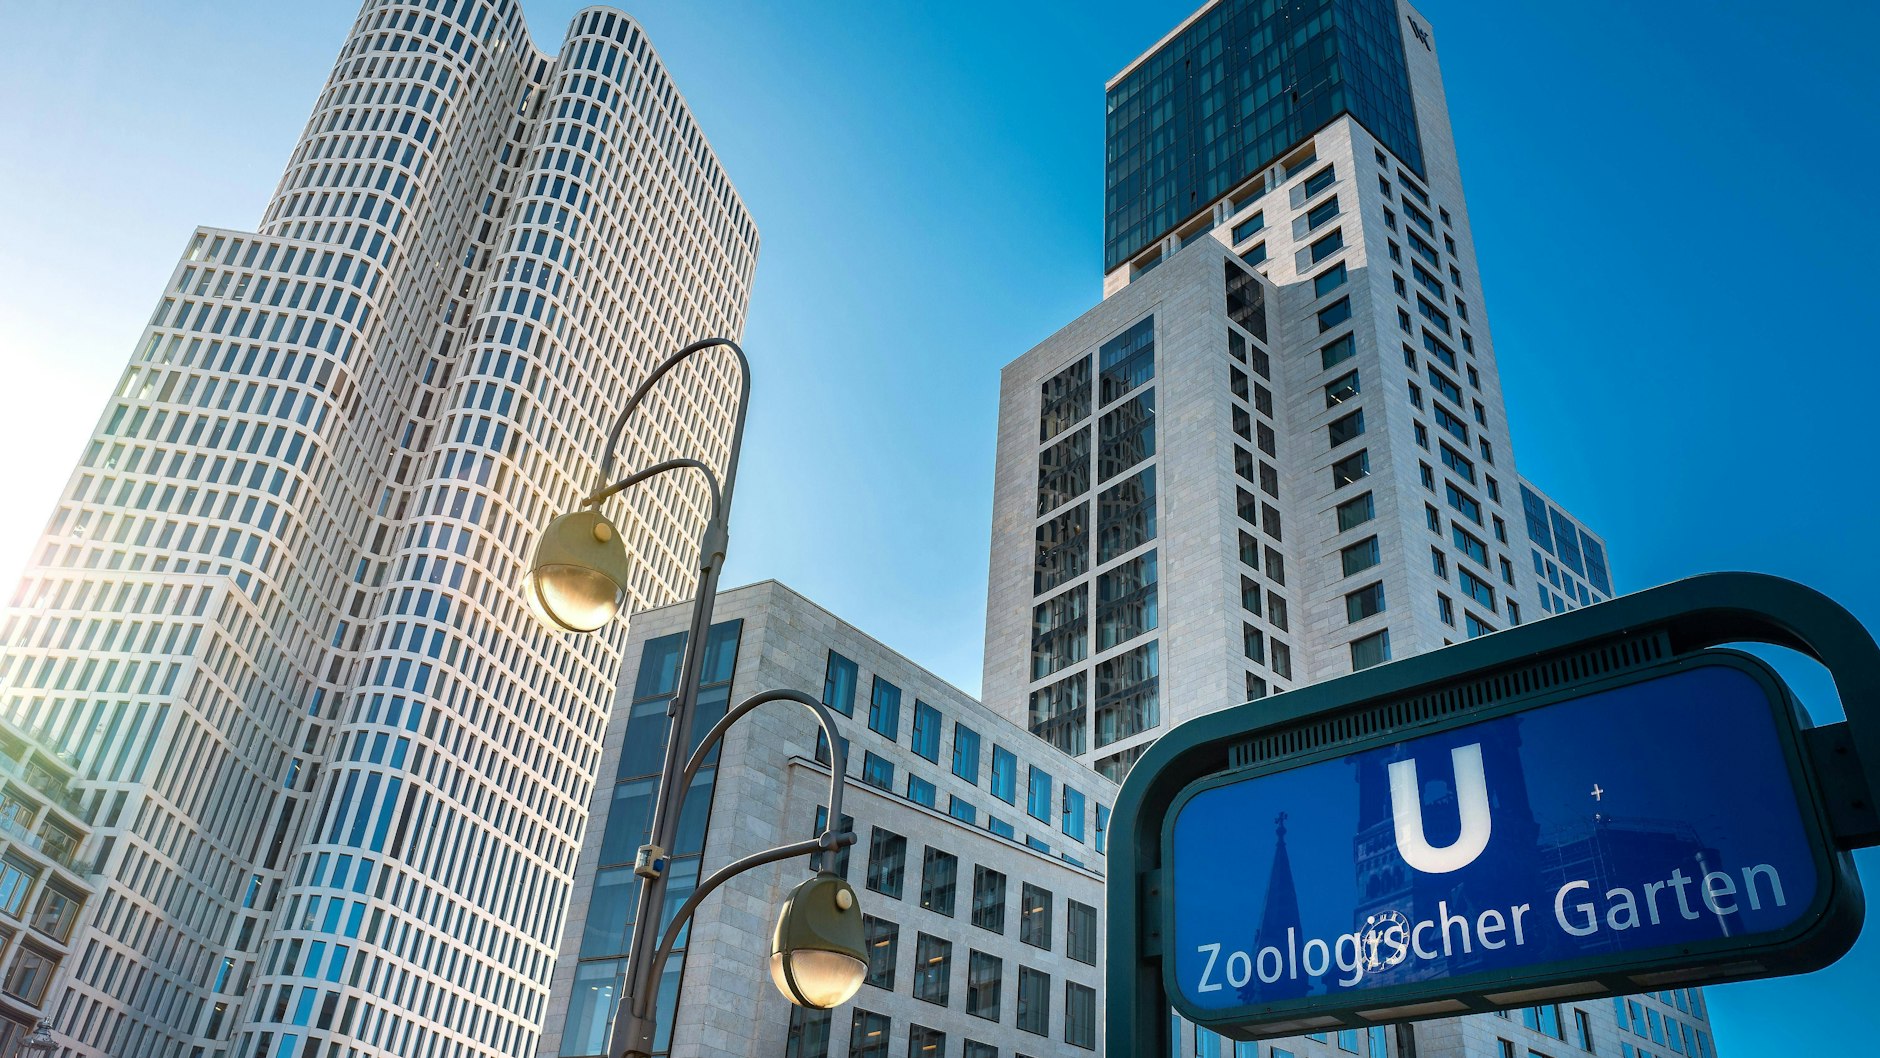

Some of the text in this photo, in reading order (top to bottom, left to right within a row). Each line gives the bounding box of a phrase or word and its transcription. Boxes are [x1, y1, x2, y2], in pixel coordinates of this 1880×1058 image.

[1388, 742, 1491, 873] U
[1197, 900, 1530, 993] Zoologischer
[1554, 863, 1786, 937] Garten
